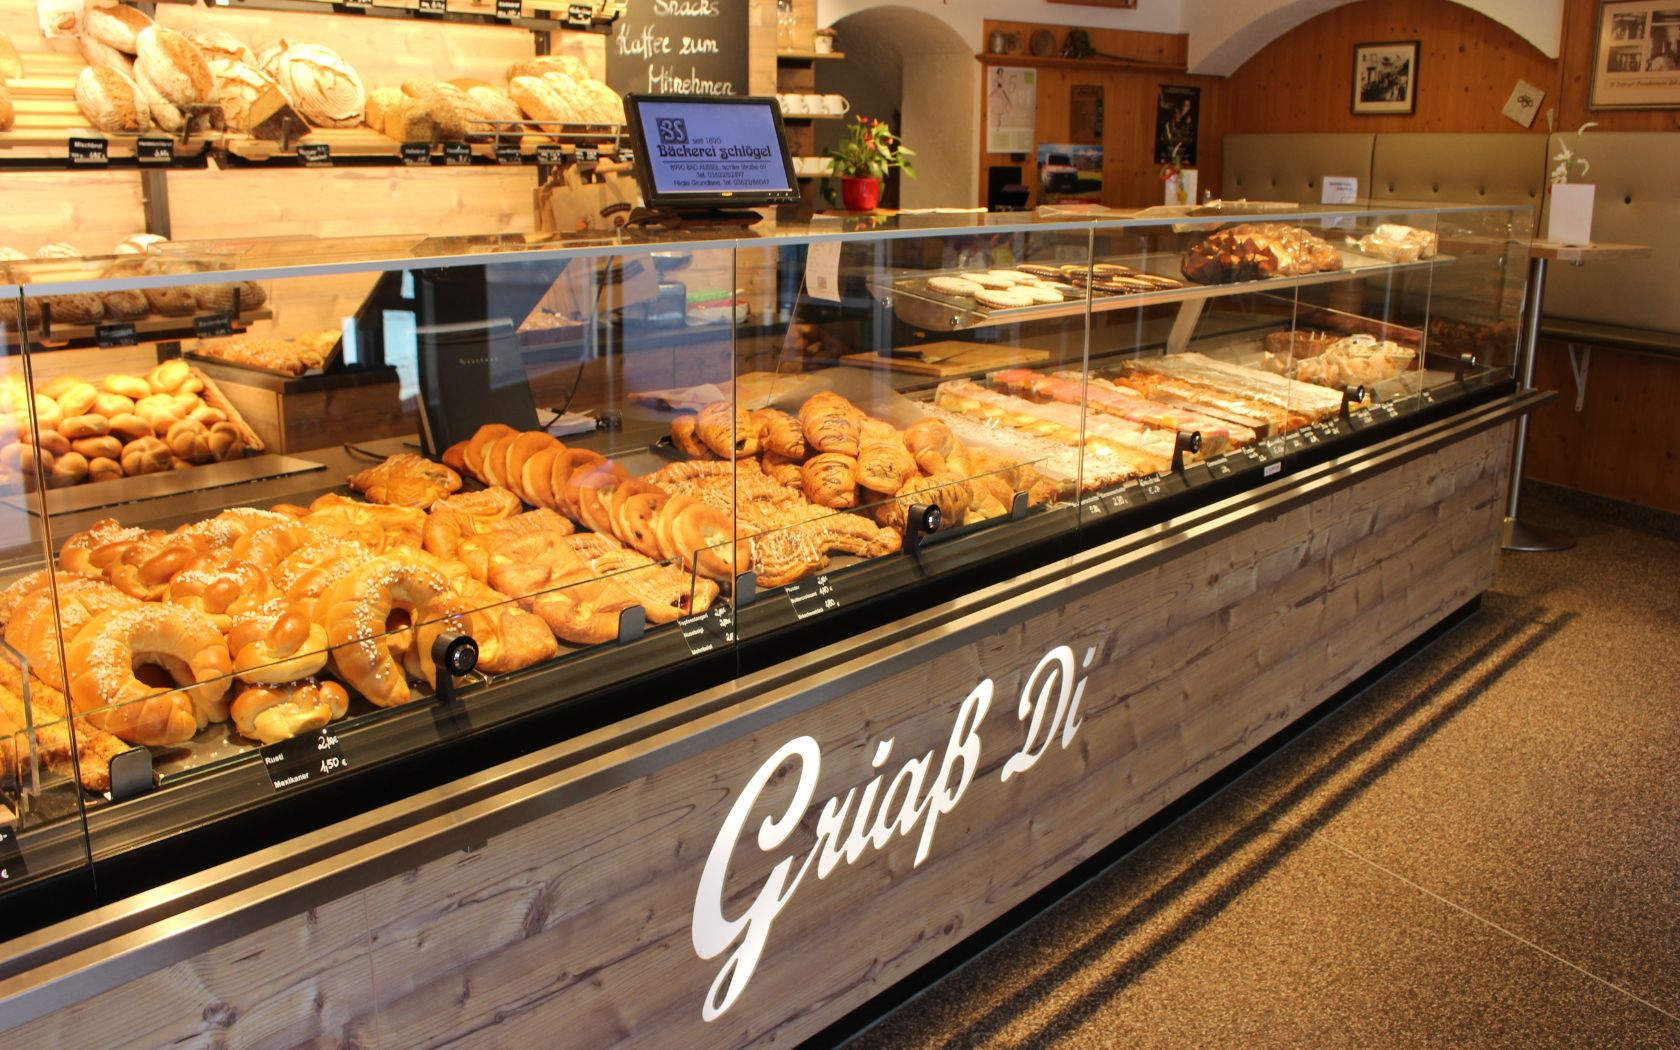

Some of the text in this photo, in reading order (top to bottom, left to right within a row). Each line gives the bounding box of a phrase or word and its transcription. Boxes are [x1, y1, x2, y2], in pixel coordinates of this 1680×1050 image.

[653, 0, 720, 16] Snacks
[616, 23, 719, 60] Kaffee zum
[648, 64, 736, 96] Mitnehmen
[657, 144, 716, 157] Bäckerei
[274, 772, 309, 789] Mexikaner
[320, 757, 340, 774] 1,50
[692, 645, 1097, 1022] Griaß Di
